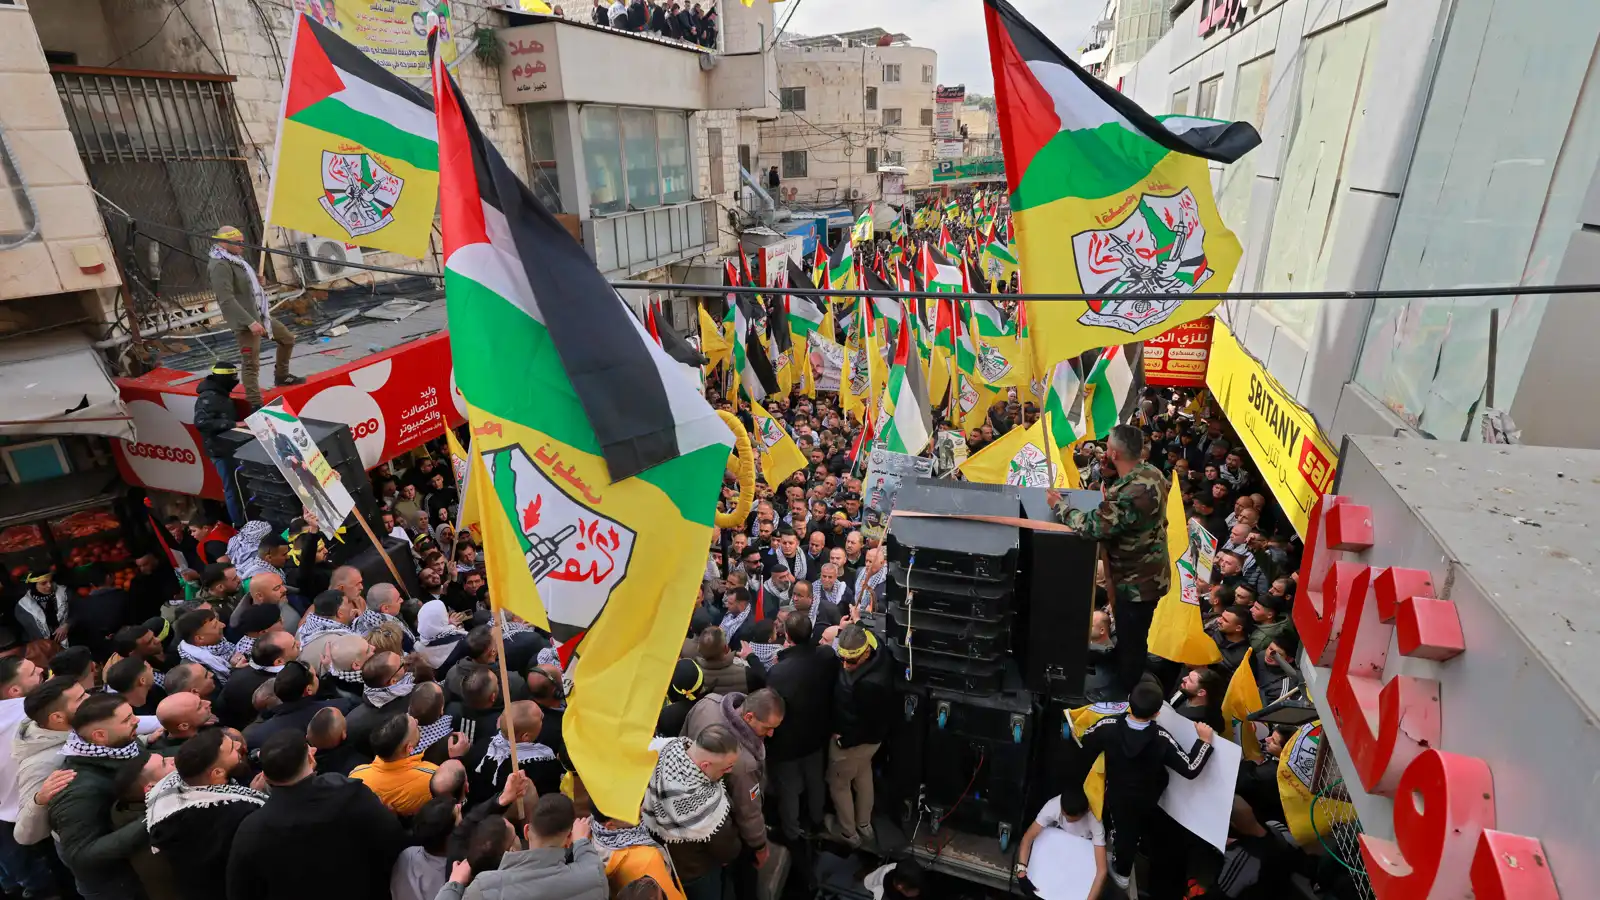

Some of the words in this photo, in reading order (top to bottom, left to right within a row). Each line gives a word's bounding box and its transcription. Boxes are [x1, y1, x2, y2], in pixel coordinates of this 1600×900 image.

[508, 40, 544, 56] هلا
[512, 60, 546, 81] هوم
[941, 162, 951, 173] P
[1178, 322, 1210, 330] منصور
[1177, 332, 1208, 348] للزي
[420, 386, 437, 399] وليد
[401, 397, 438, 419] للاتصالات
[1248, 373, 1301, 458] SBITANY
[399, 411, 441, 438] والكمبيوتر
[127, 442, 195, 464] ooredoo
